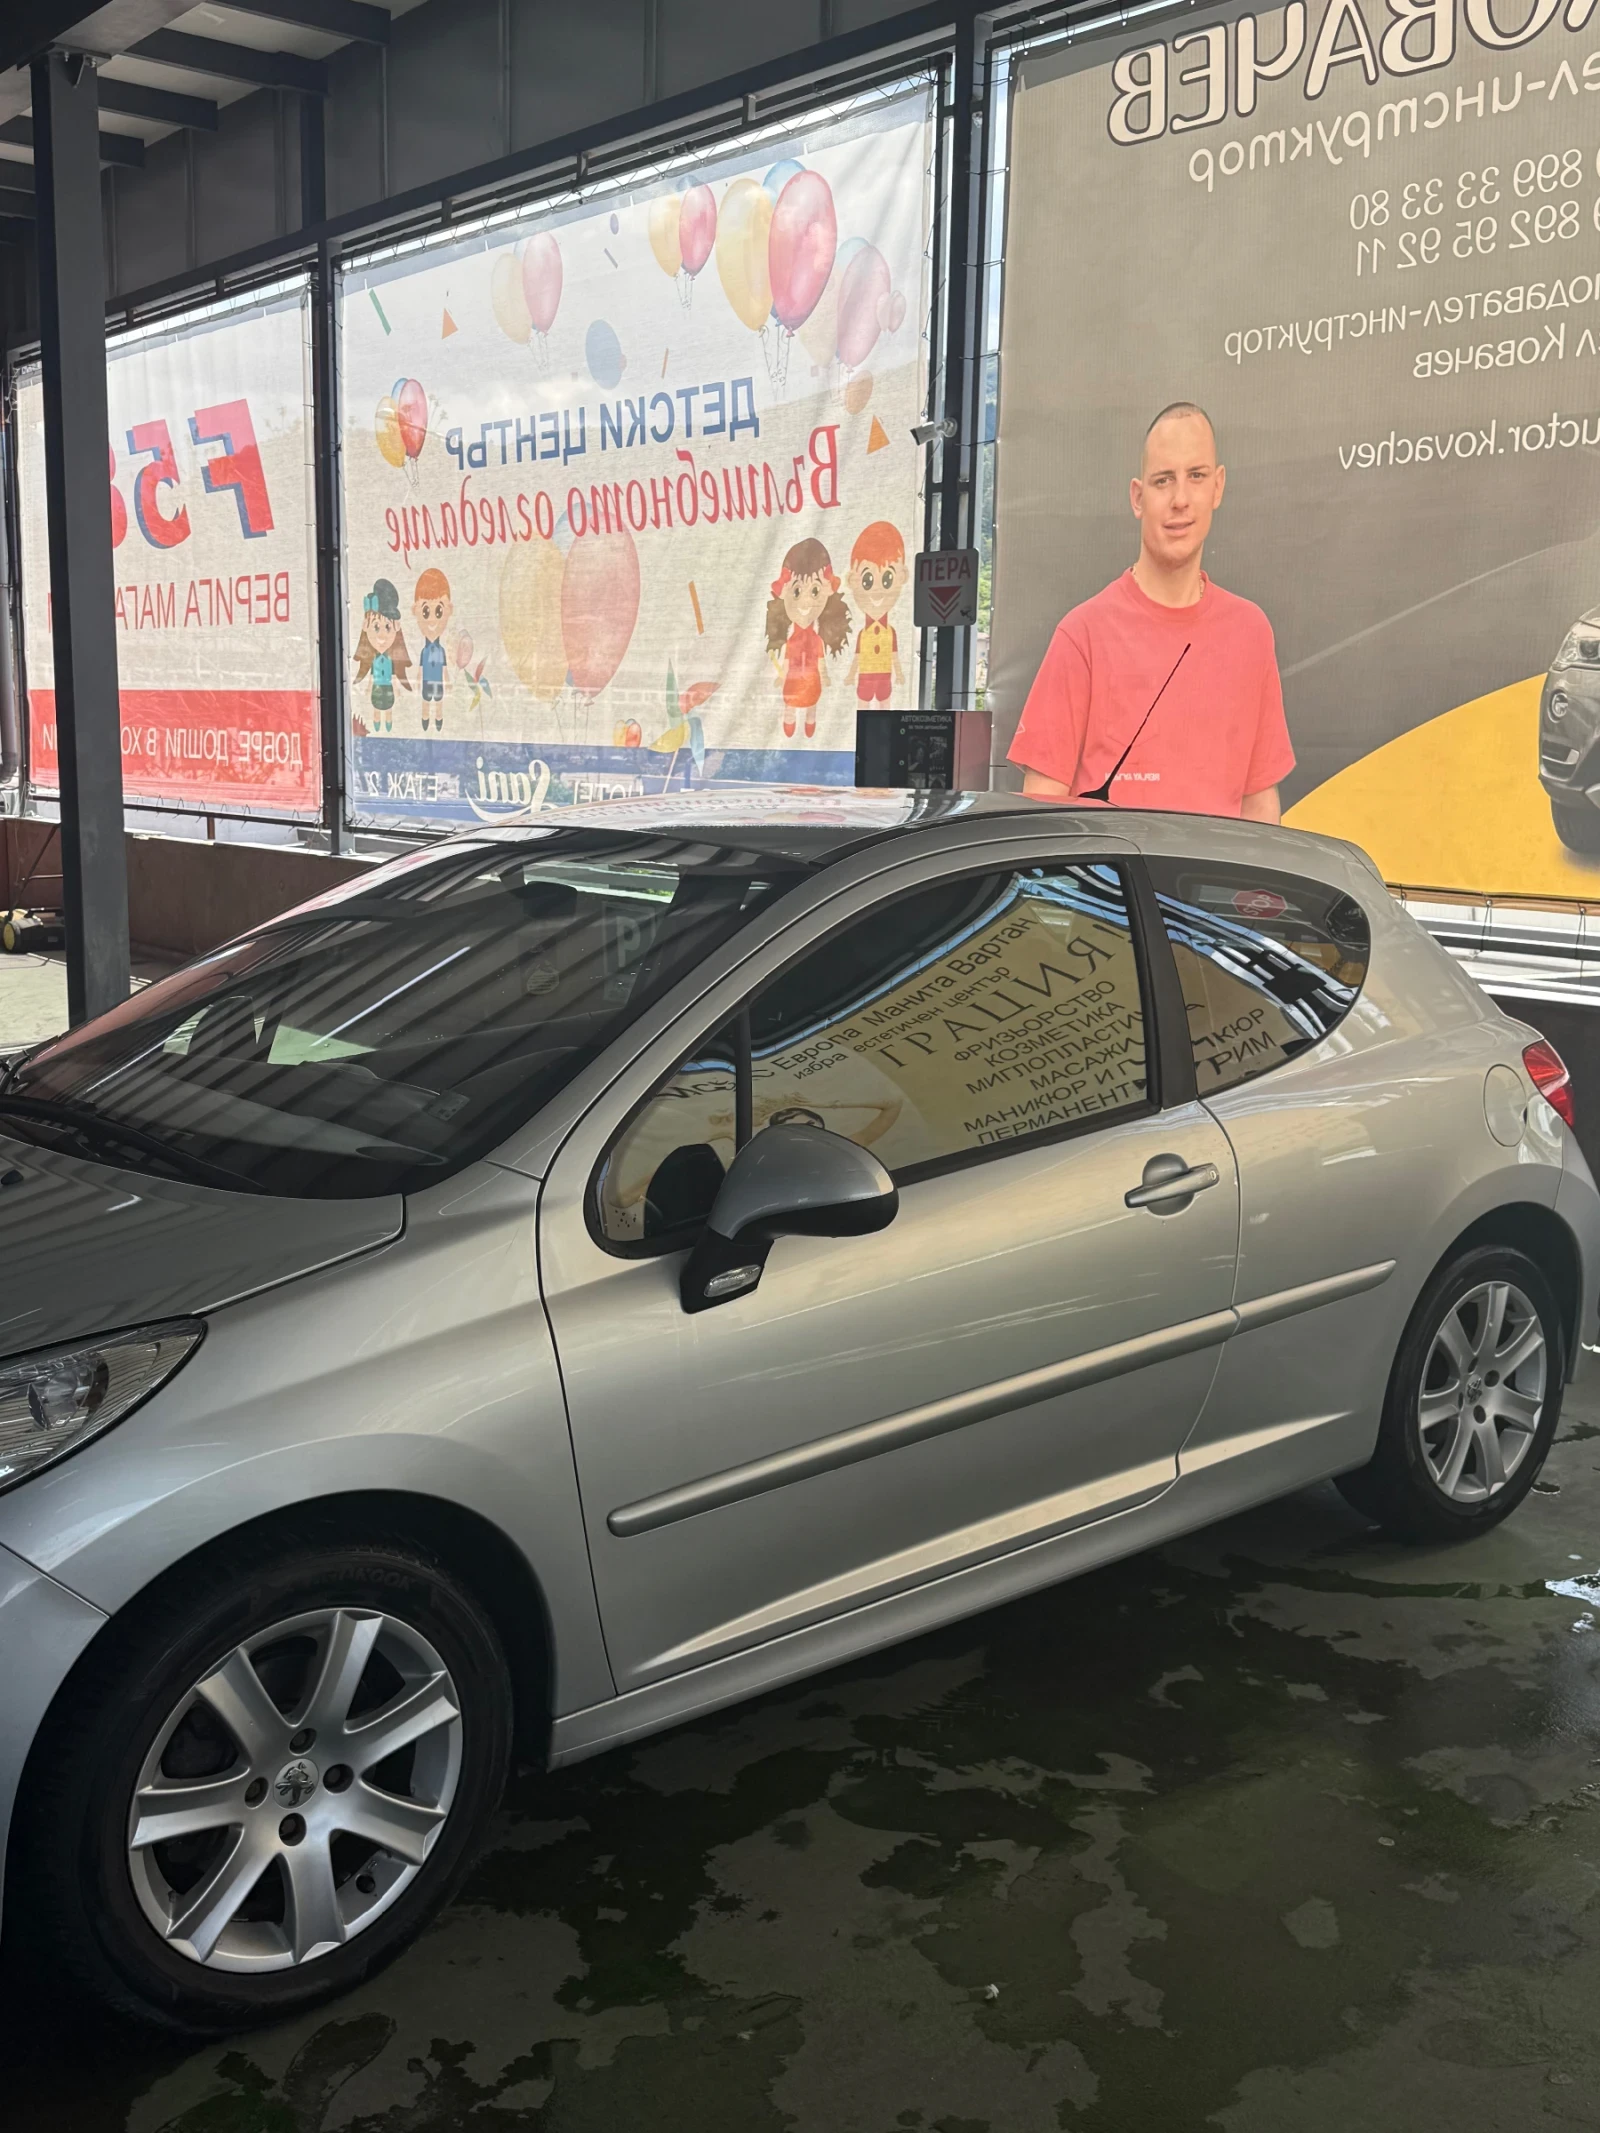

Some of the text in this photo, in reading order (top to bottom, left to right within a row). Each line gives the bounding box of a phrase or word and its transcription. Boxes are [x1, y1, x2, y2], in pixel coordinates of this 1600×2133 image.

[919, 556, 971, 582] ПЕРА
[1243, 894, 1275, 916] STOP
[770, 1027, 862, 1070] Европа
[862, 975, 957, 1027] Манита
[793, 966, 1011, 1080] избра естетичен център
[954, 980, 1116, 1062] ФРИЗЬОРСТВО
[984, 1000, 1126, 1068] КОЗМЕТИКА
[963, 1080, 1087, 1133] МАНИКЮР
[1095, 1068, 1115, 1085] И
